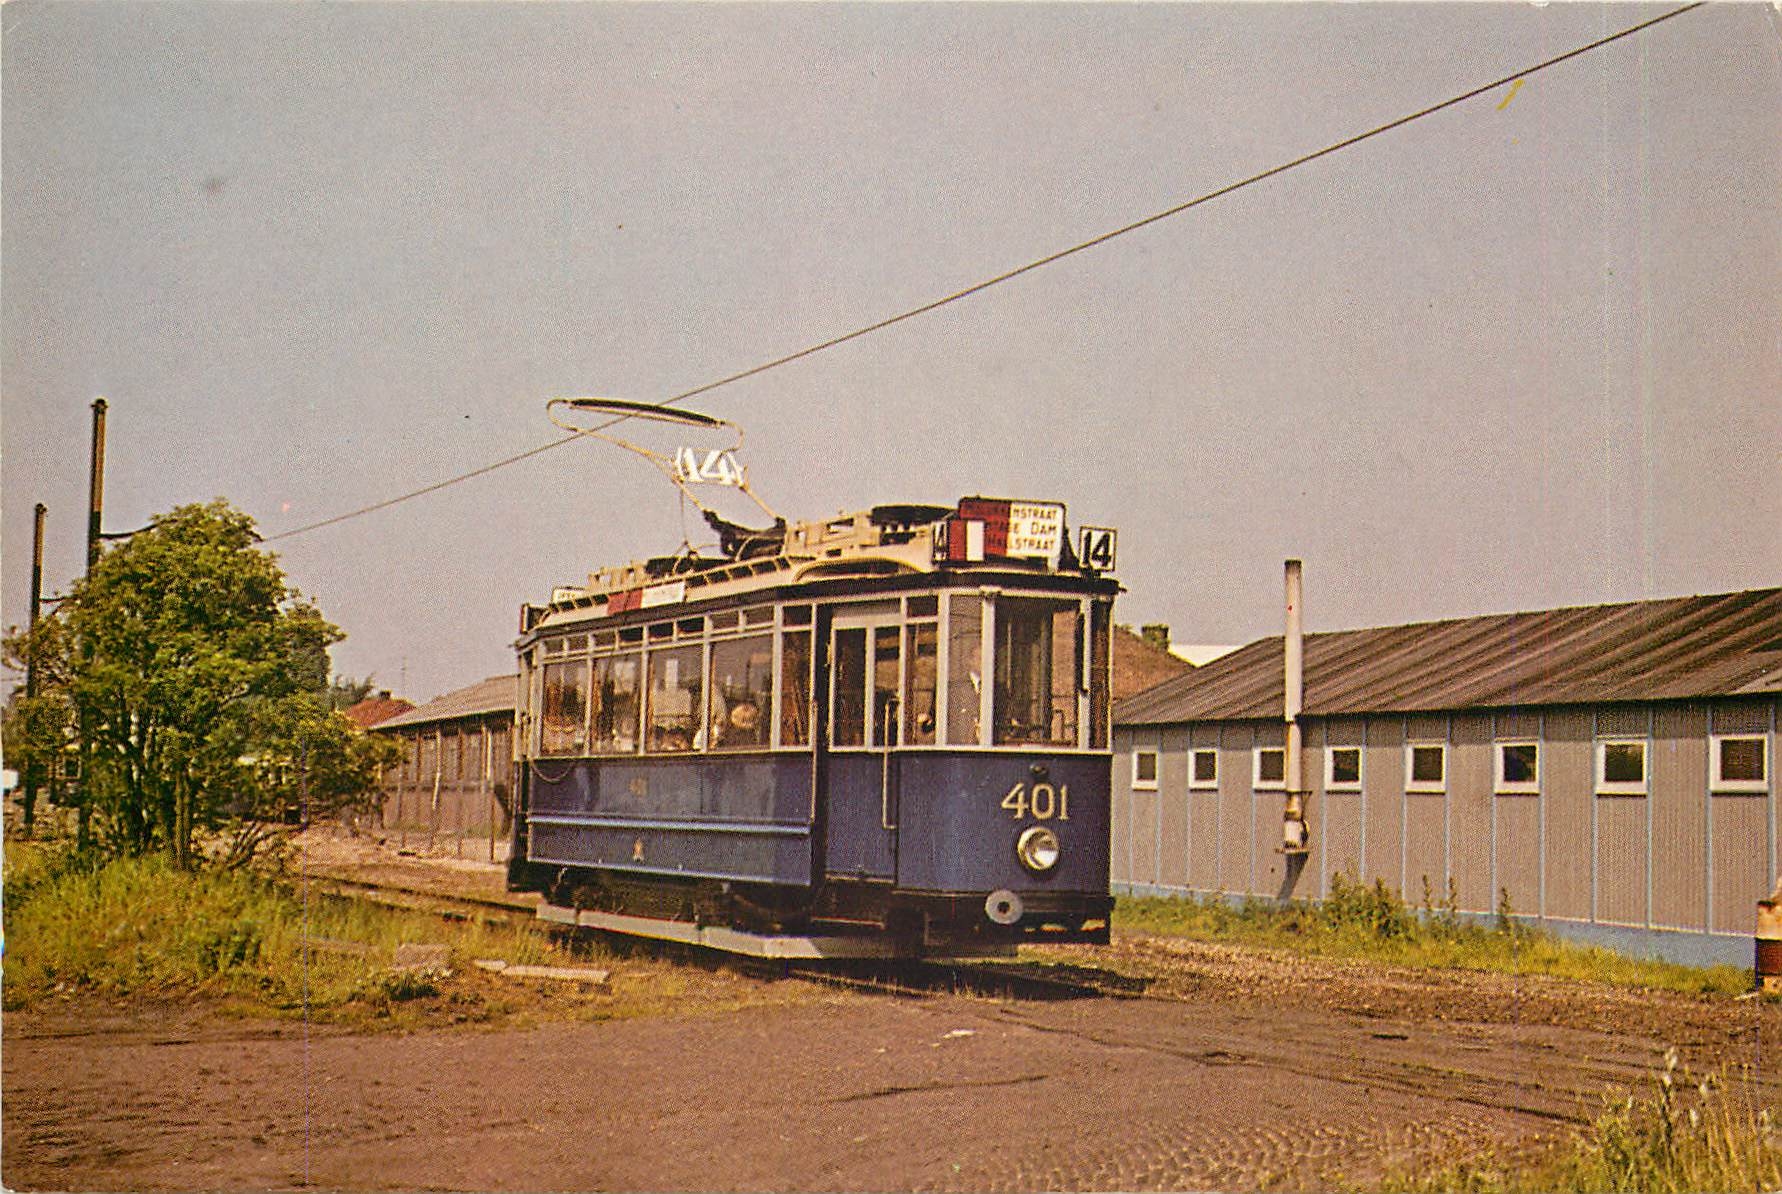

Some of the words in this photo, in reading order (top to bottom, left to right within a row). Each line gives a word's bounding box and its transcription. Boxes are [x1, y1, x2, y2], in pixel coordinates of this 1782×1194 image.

[1031, 521, 1056, 535] DAM
[1082, 531, 1111, 567] 14
[1001, 782, 1069, 820] 401
